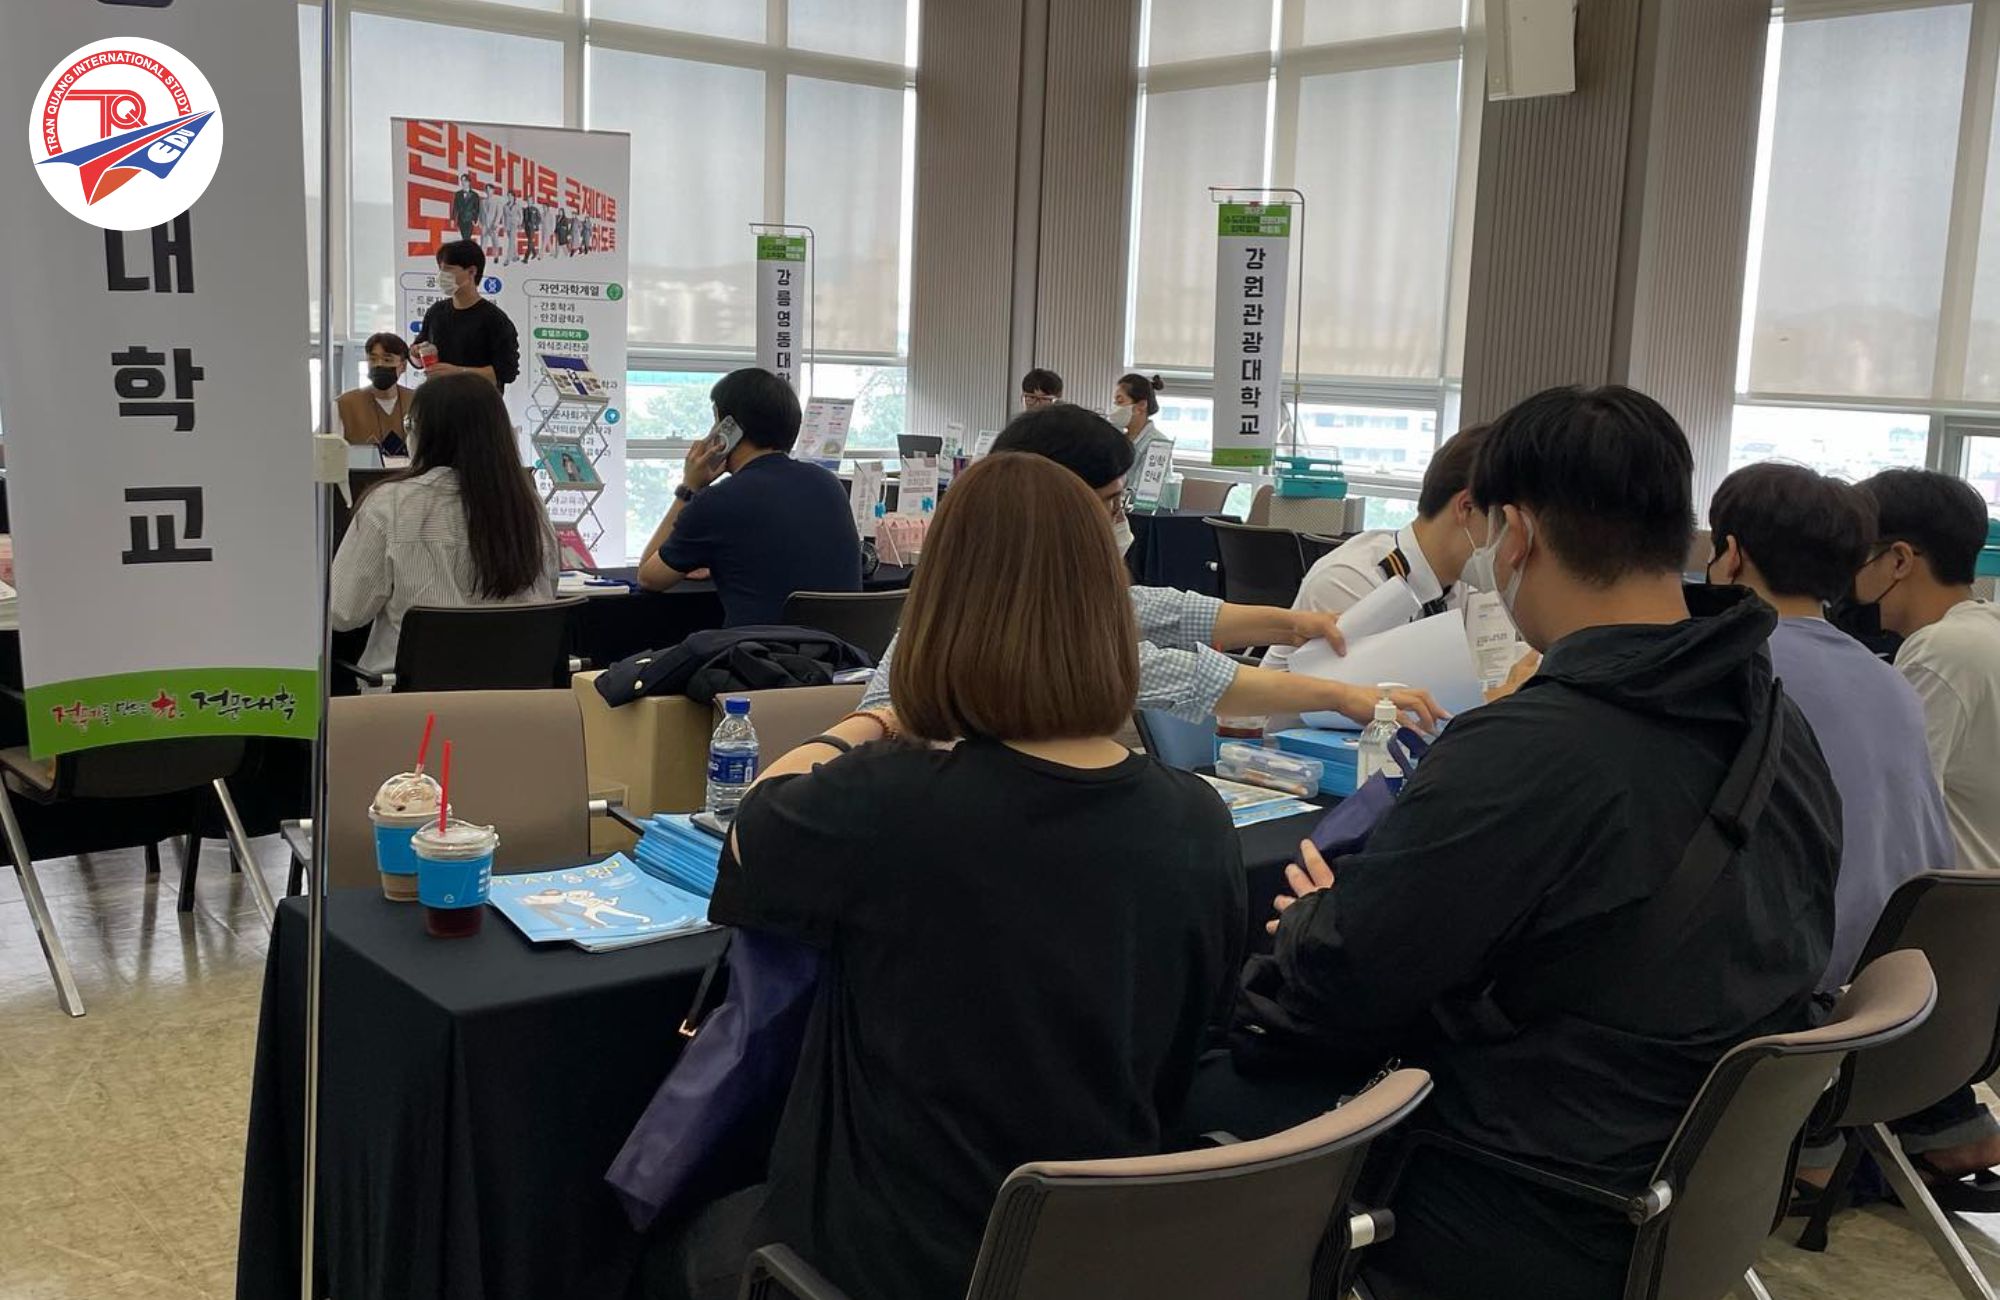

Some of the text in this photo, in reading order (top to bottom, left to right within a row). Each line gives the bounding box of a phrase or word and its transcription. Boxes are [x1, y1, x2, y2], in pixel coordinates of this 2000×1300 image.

[406, 120, 559, 208] 탄탄대로
[539, 283, 600, 297] 자연과학계열
[1239, 248, 1266, 436] 강원관광대학교
[190, 684, 296, 721] 전문대학
